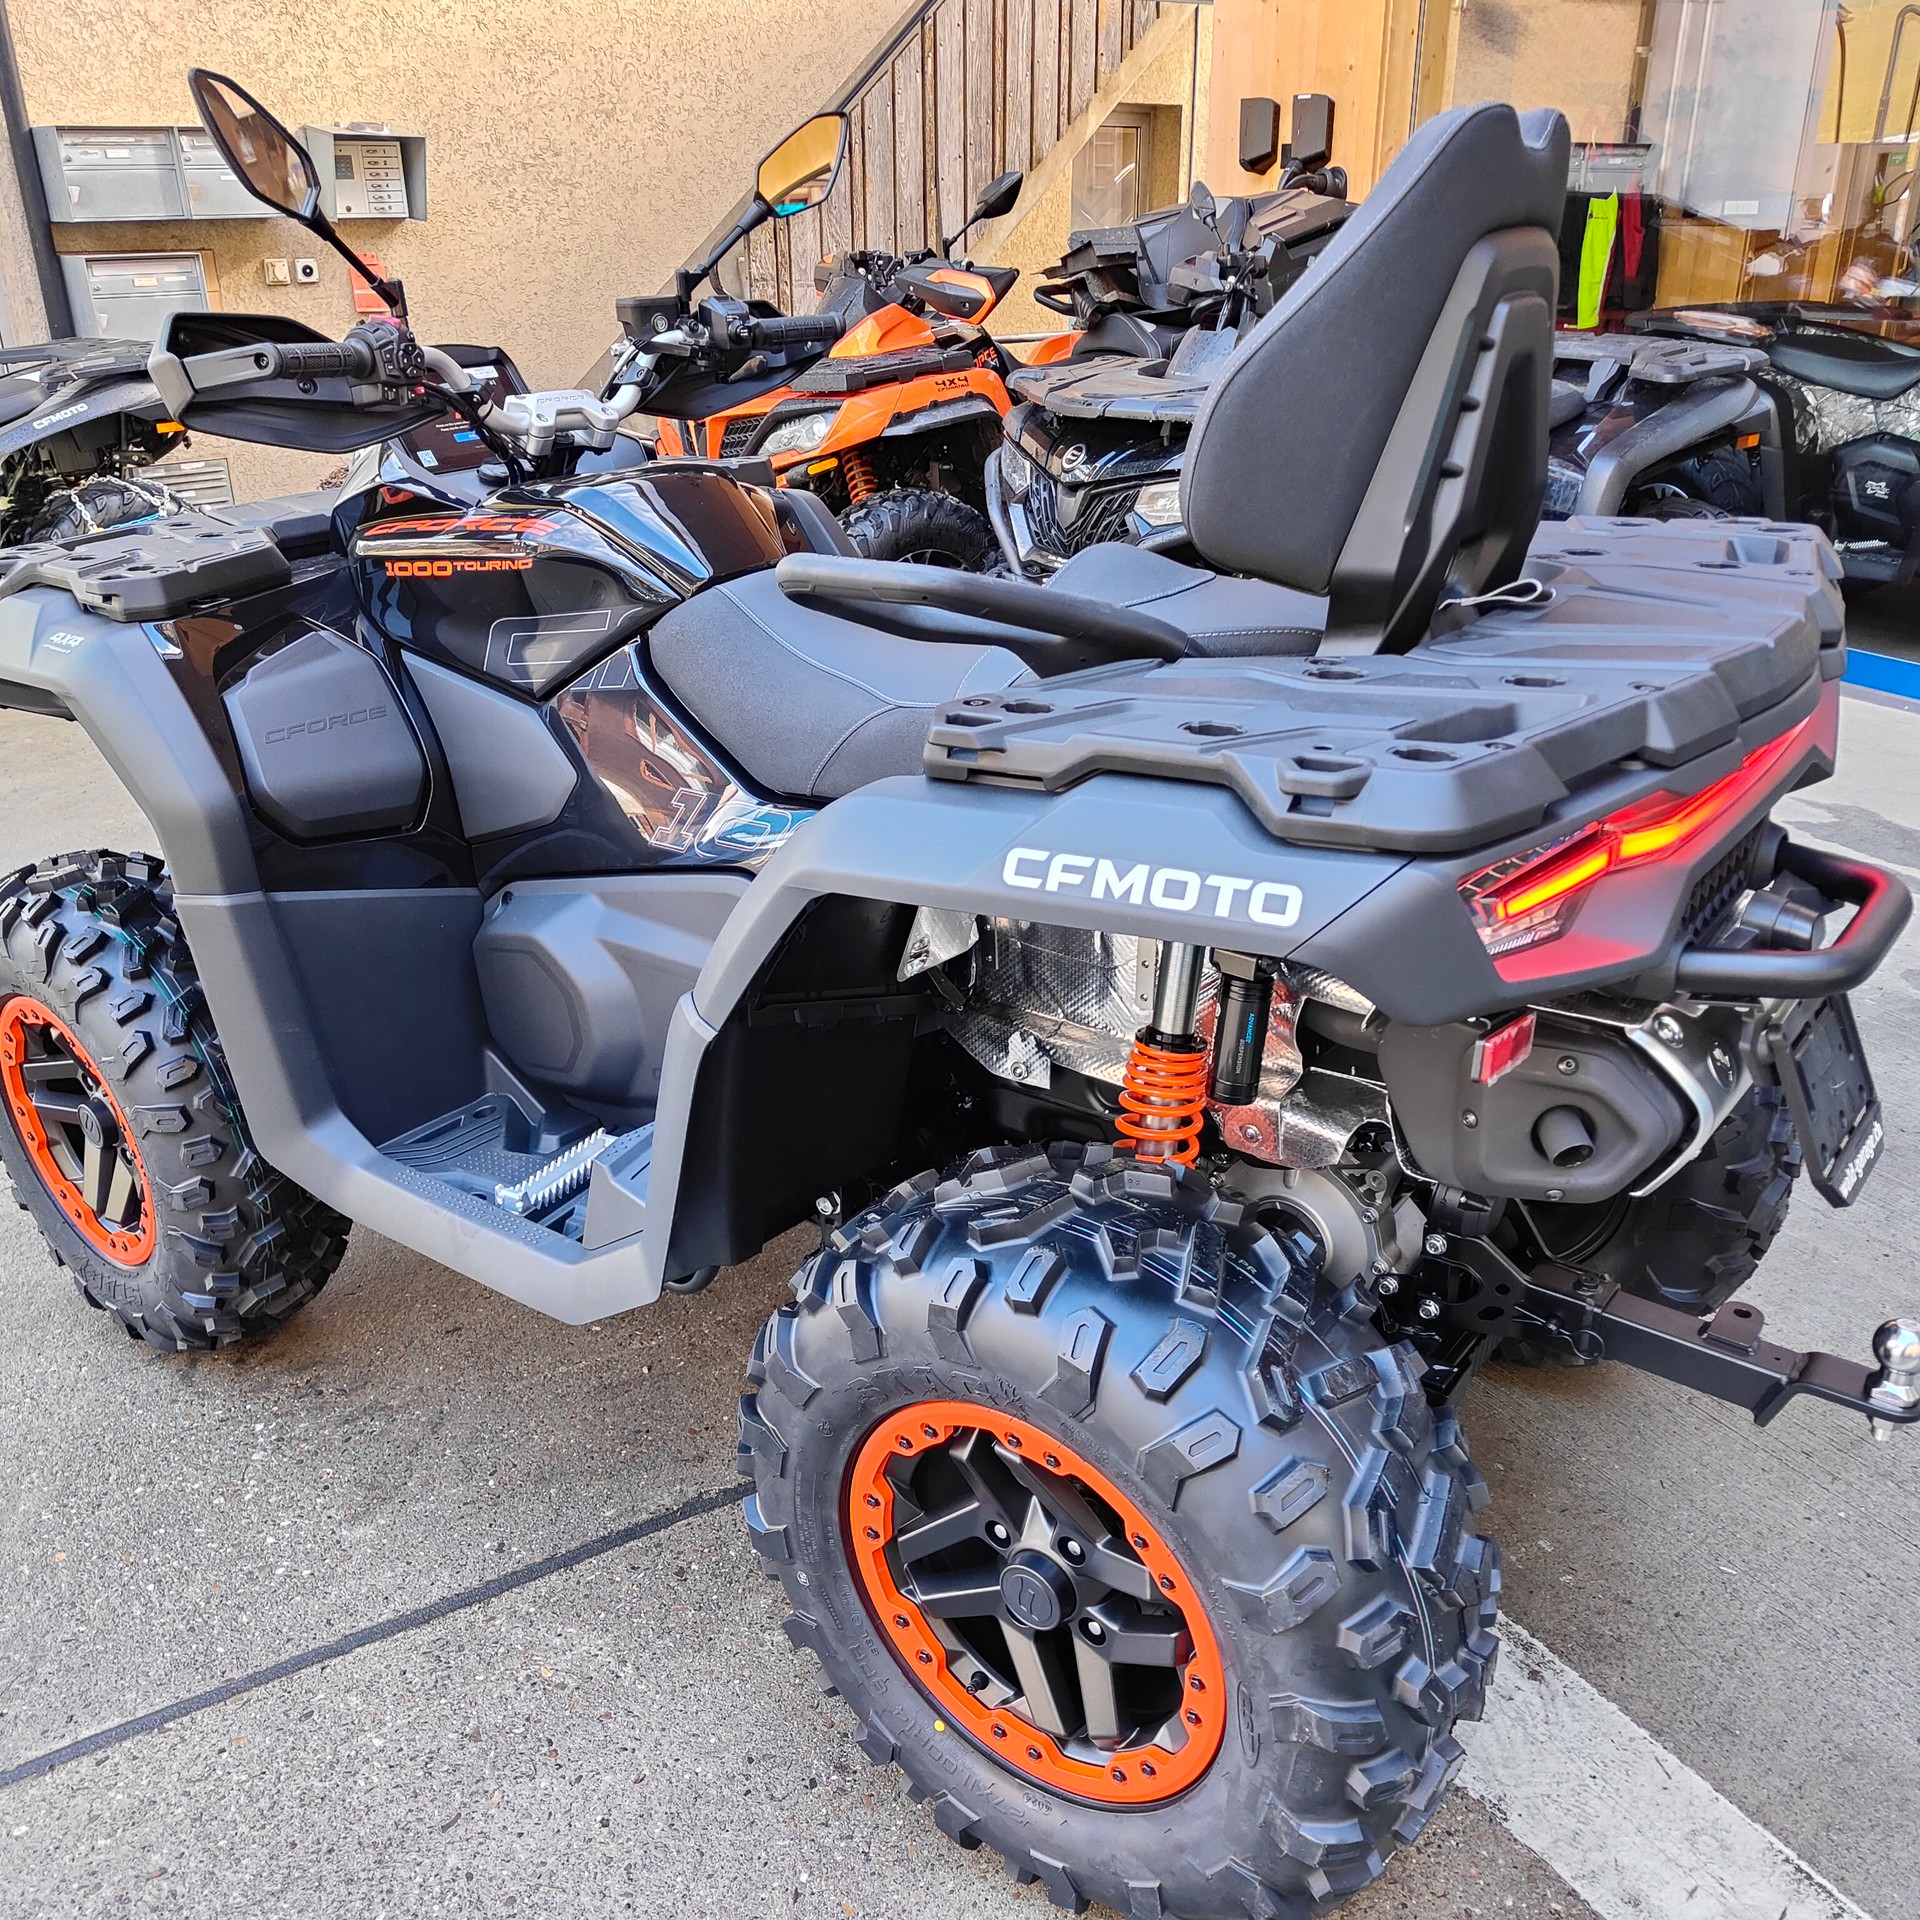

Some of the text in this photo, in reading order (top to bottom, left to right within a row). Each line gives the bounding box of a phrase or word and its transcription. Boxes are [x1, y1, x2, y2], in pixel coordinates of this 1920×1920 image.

[32, 402, 89, 430] CFMOTO
[364, 515, 561, 537] CFORCE
[385, 558, 533, 577] 1000 TOURING
[264, 705, 387, 744] CFORCE
[1002, 847, 1303, 927] CFMOTO
[1245, 1012, 1255, 1044] ADVANCED
[1235, 1038, 1245, 1074] SUSPENSION
